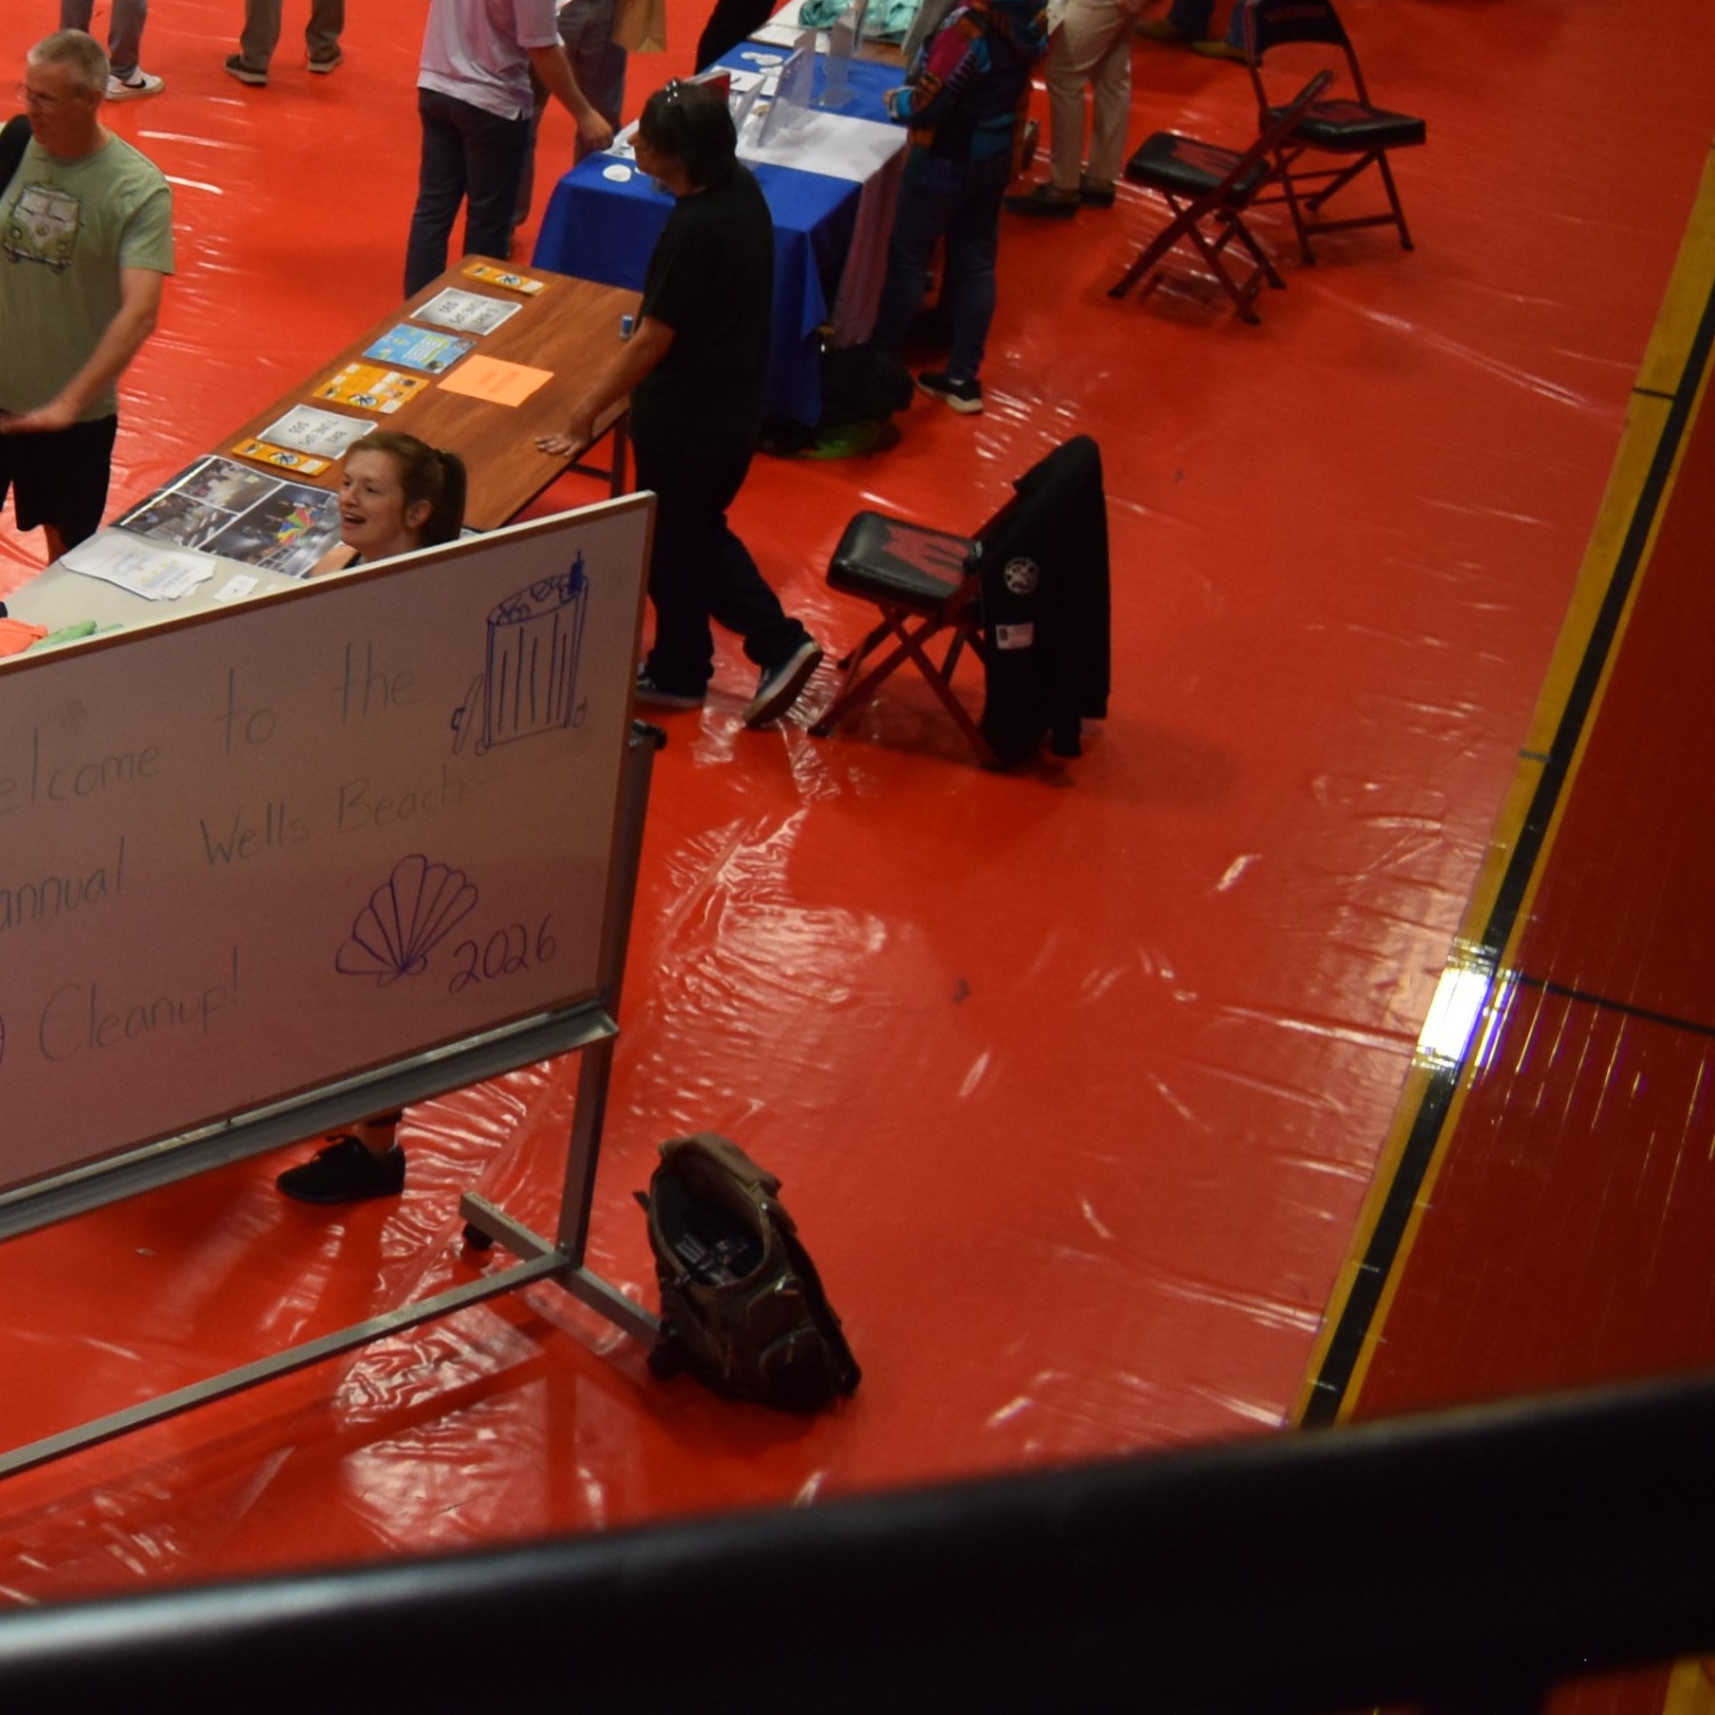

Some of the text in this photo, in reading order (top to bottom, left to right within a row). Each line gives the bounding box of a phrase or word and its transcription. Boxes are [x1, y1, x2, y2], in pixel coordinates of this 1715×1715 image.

[212, 666, 276, 756] to
[332, 640, 416, 721] the
[199, 800, 310, 867] Wells
[338, 764, 467, 835] Beach
[37, 944, 239, 1064] Cleanup!
[447, 911, 558, 995] 2026
